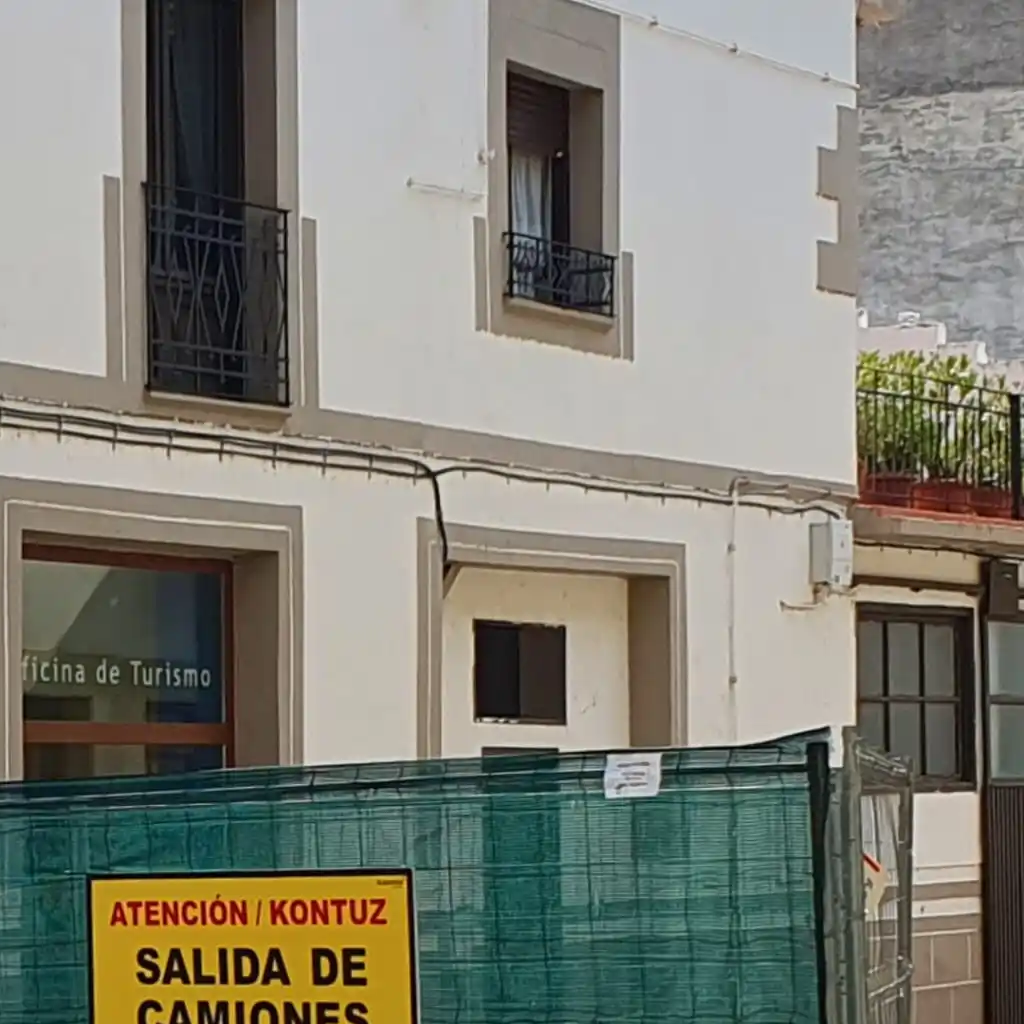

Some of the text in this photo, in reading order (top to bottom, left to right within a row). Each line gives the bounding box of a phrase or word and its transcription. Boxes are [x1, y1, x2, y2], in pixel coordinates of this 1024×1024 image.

[22, 655, 211, 688] ficina de Turismo
[110, 894, 248, 926] ATENCIÓN
[269, 898, 388, 925] KONTUZ
[136, 947, 368, 986] SALIDA DE
